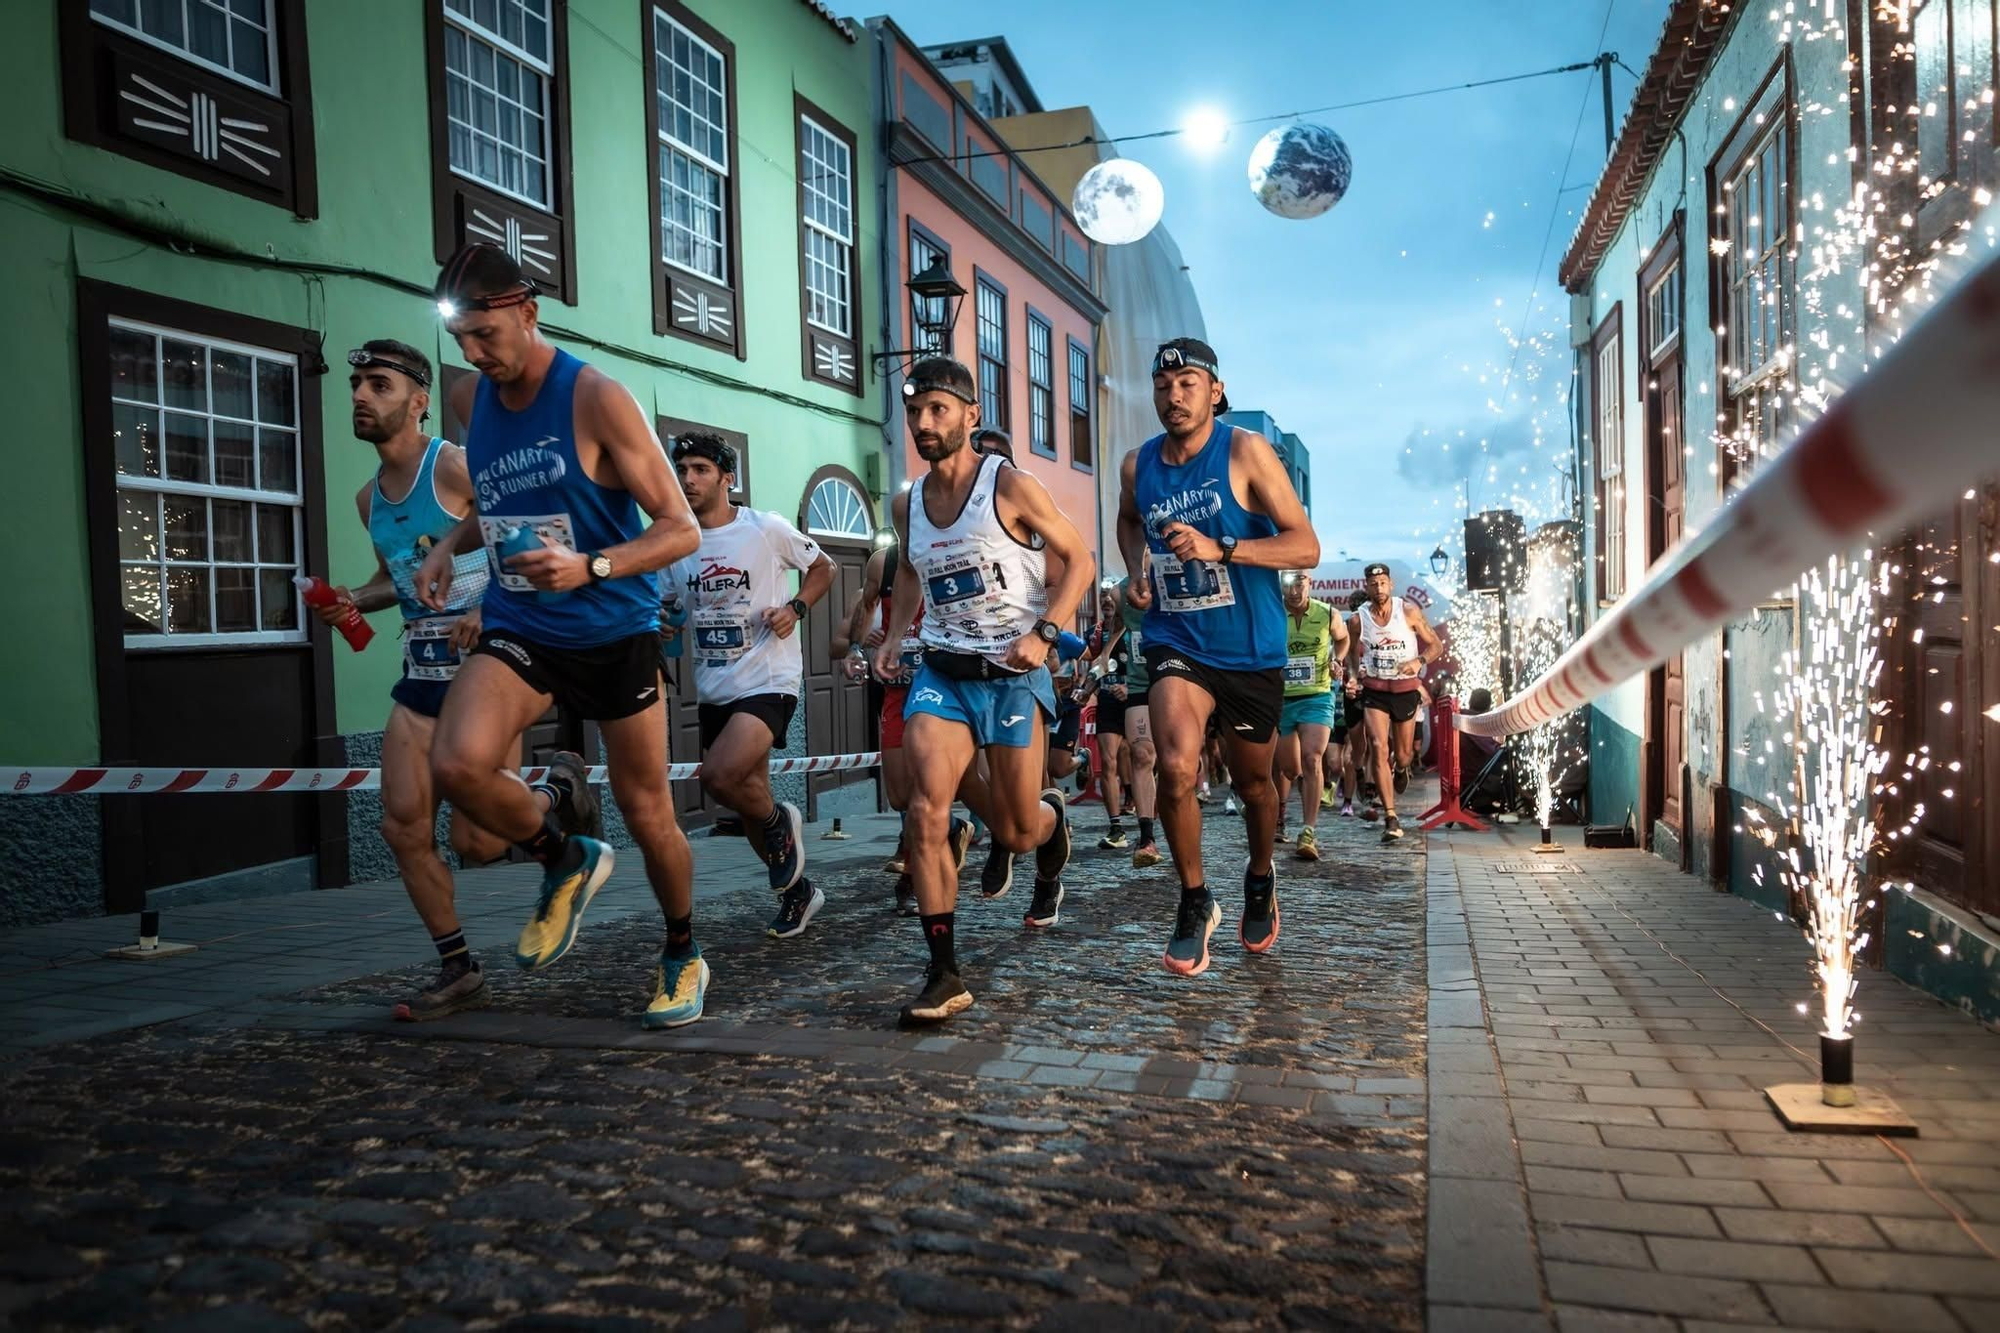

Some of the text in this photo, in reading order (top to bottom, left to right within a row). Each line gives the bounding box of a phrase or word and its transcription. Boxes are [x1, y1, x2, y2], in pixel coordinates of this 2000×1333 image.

[490, 447, 543, 479] CANARY
[499, 471, 548, 496] RUNNER
[686, 569, 751, 593] HILERA
[943, 577, 959, 596] 3
[706, 629, 728, 644] 45
[423, 643, 436, 660] 4
[913, 653, 923, 665] 9
[1288, 669, 1302, 678] 38
